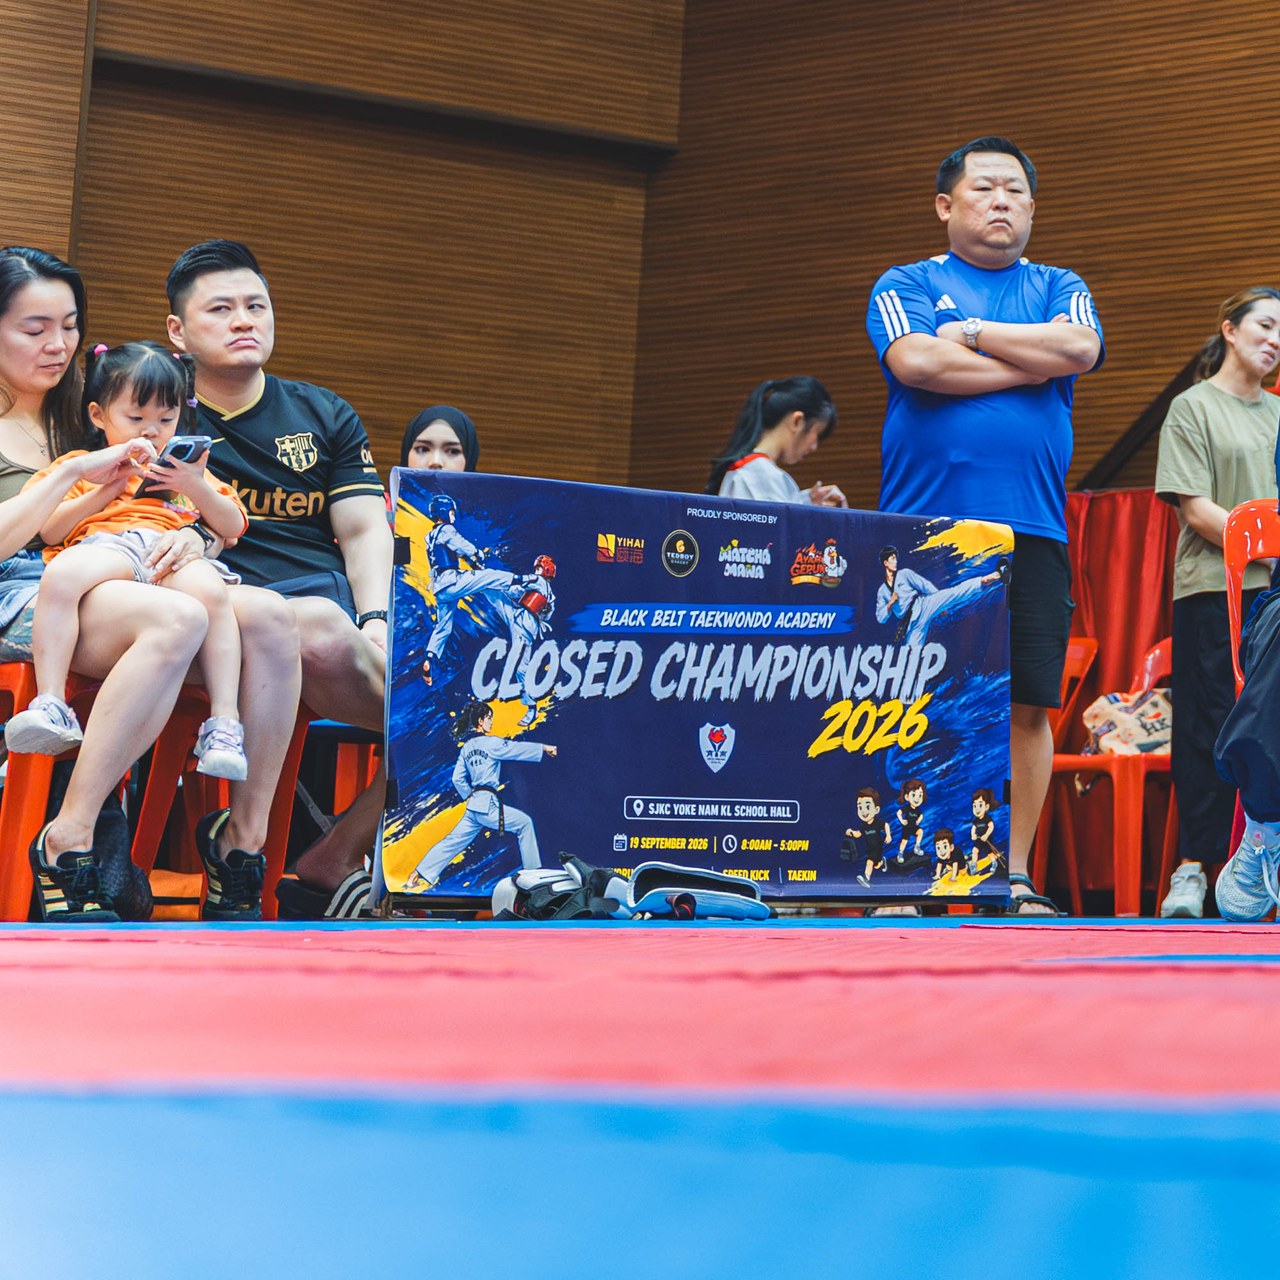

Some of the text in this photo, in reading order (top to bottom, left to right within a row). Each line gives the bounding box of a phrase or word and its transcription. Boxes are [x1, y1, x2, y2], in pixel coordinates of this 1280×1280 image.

[231, 479, 325, 517] kuten
[686, 507, 778, 525] PROUDLY SPONSORED BY
[616, 536, 645, 549] YIHAI
[666, 552, 695, 561] TEDBOY
[718, 546, 772, 565] MATCHA
[600, 608, 836, 629] BLACK BELT TAEKWONDO ACADEMY
[470, 638, 947, 705] CLOSED CHAMPIONSHIP
[807, 692, 932, 758] 2026
[648, 802, 792, 818] SJKC YOKE NAM KL SCHOOL HALL
[629, 836, 709, 850] 19 SEPTEMBER 2026
[740, 838, 772, 851] 8:00AM
[779, 839, 810, 852] 5:00PM
[750, 870, 770, 881] KICK
[787, 870, 817, 882] TAEKIN
